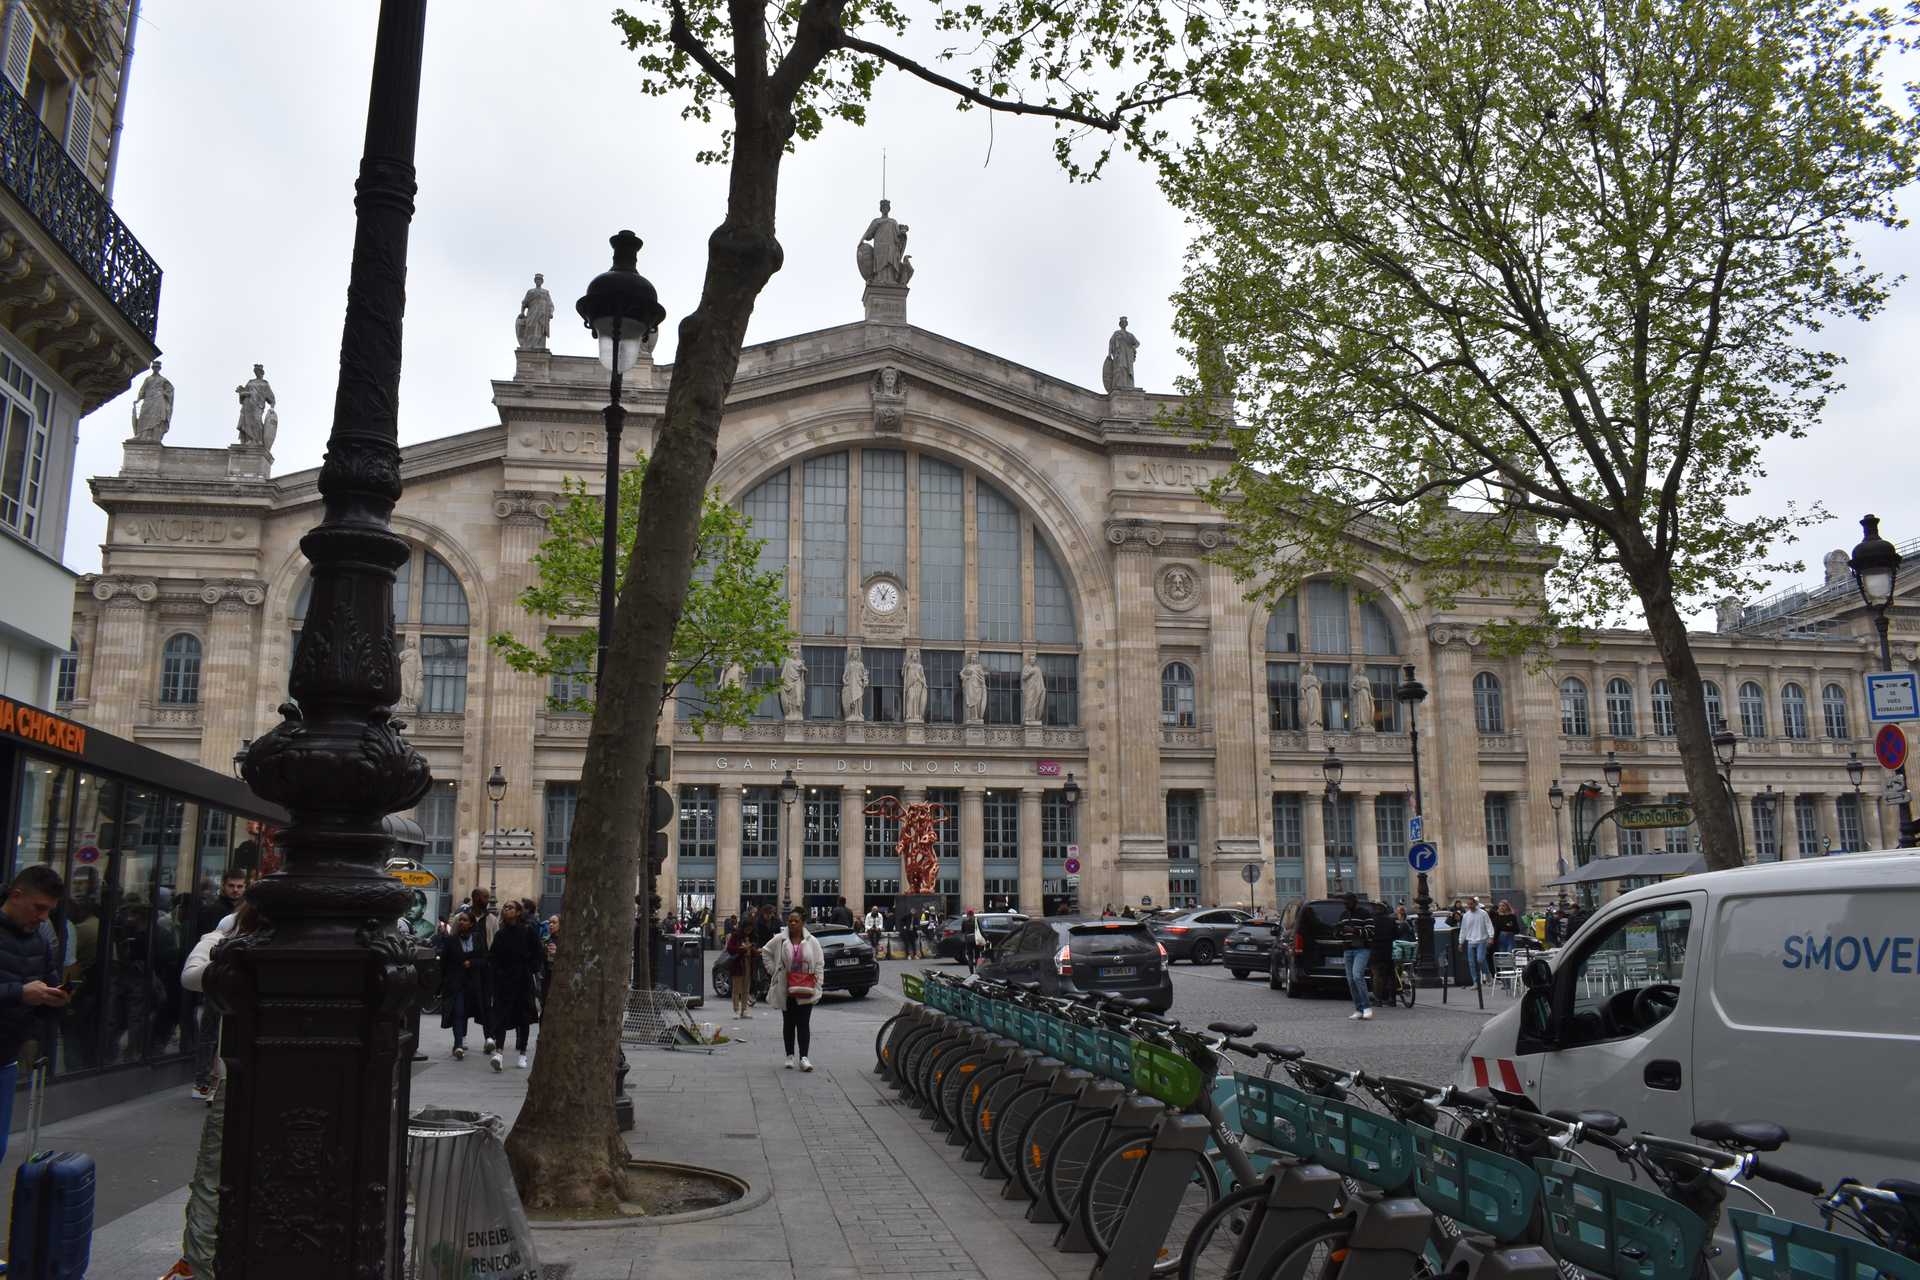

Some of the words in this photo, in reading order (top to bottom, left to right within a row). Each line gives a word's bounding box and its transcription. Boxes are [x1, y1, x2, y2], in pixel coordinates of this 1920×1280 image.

[540, 430, 609, 455] NOR
[1142, 463, 1210, 488] NORD
[142, 519, 227, 543] NORD
[16, 706, 87, 754] CHICKEN
[715, 756, 805, 771] GARE
[836, 758, 873, 772] DU
[901, 759, 987, 774] NORD
[1781, 935, 1920, 974] SMOVE
